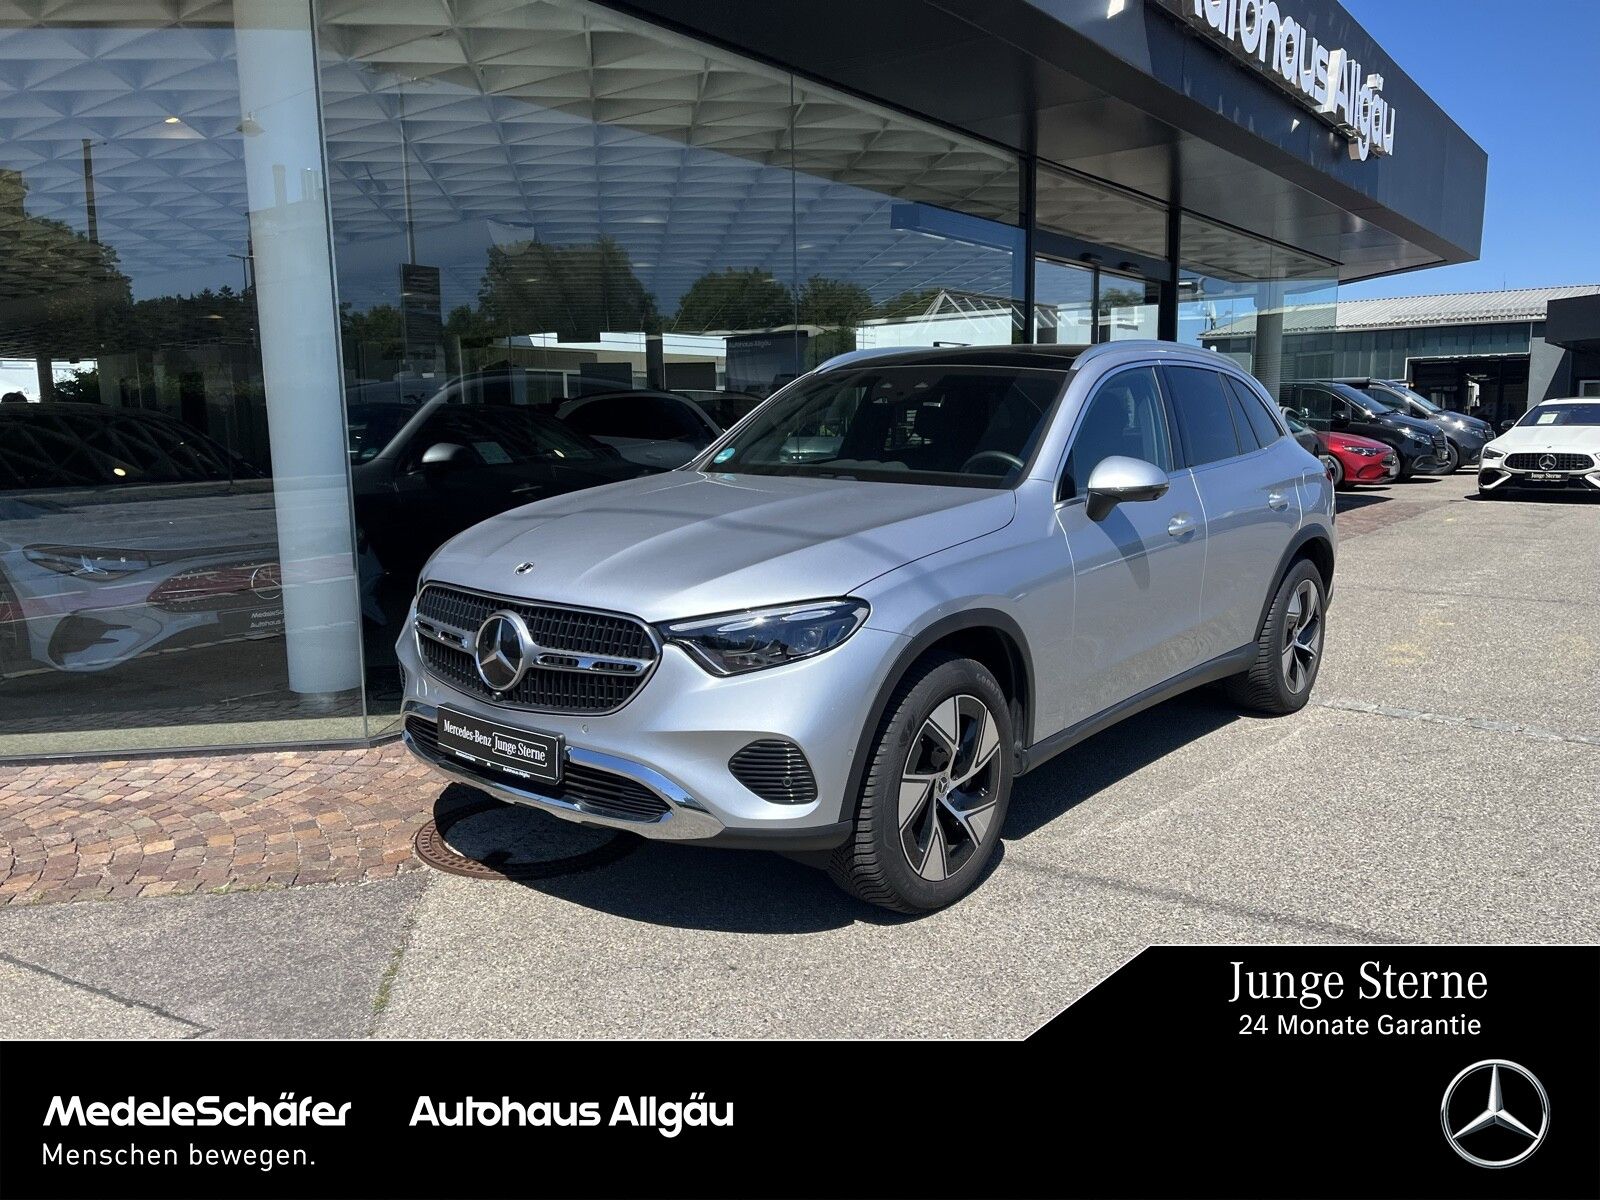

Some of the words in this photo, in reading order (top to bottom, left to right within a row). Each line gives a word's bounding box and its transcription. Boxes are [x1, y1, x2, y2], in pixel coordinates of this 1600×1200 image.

[1194, 0, 1330, 106] ohaus
[1325, 47, 1396, 162] Allgäu
[443, 719, 492, 747] Mercedes-Benz
[494, 735, 517, 756] Junge
[517, 742, 546, 762] Sterne
